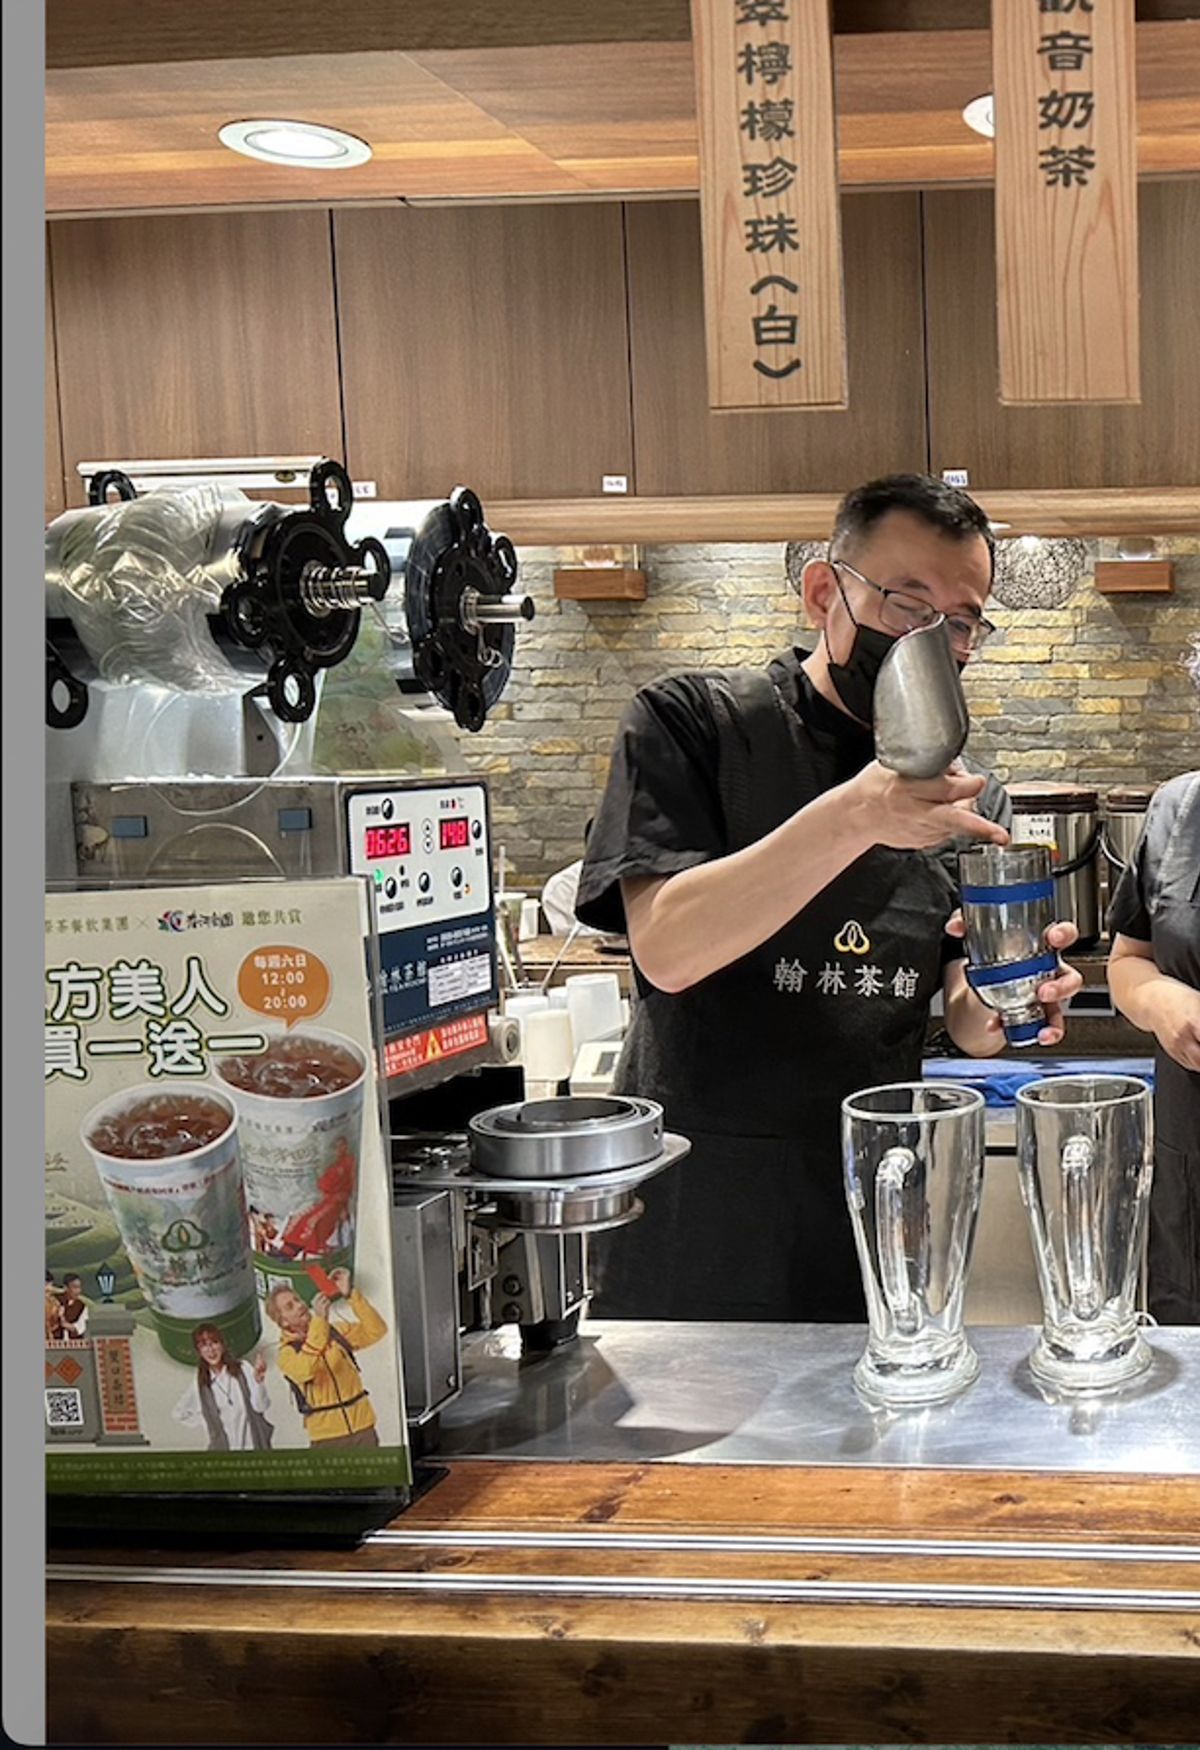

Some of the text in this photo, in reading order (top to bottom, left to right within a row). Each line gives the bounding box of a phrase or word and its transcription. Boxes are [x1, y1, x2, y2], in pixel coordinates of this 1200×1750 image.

[45, 956, 228, 1022] 方美人
[262, 970, 305, 986] 12:00
[773, 957, 920, 1000] 翰林茶館
[263, 994, 308, 1010] 20:00
[45, 1017, 264, 1080] 買一送一
